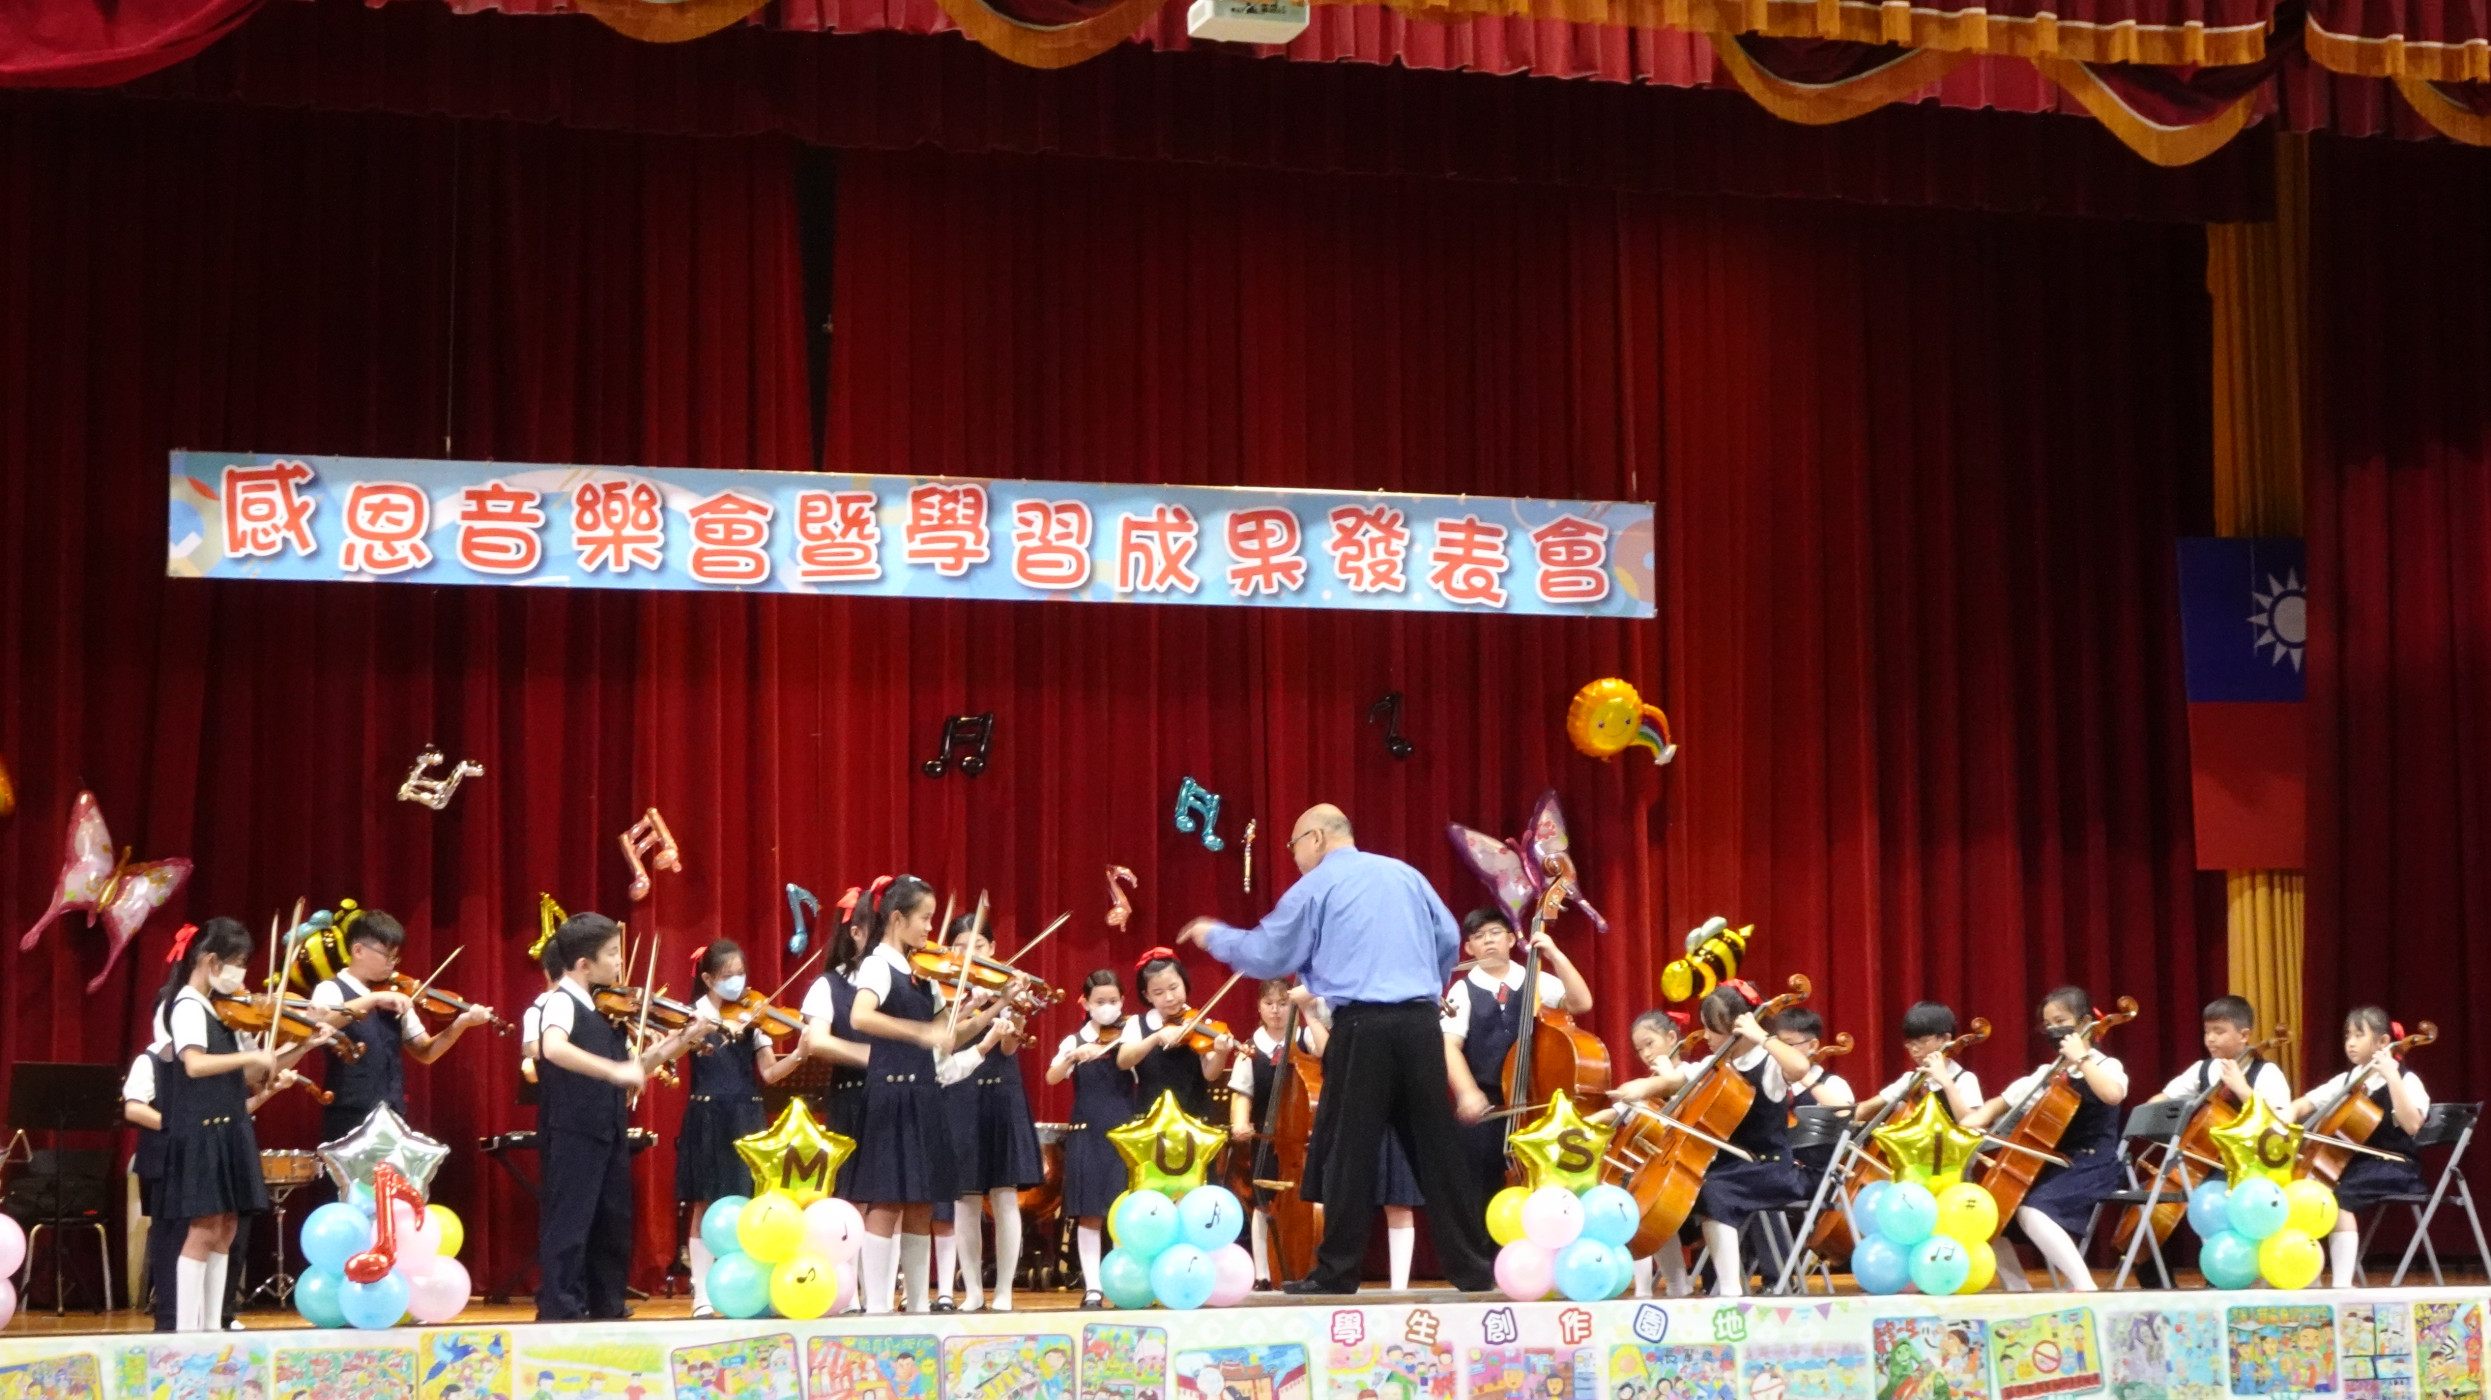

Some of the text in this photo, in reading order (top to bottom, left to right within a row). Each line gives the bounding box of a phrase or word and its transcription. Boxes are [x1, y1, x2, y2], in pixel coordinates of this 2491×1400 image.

[221, 459, 1610, 608] 感恩音樂會暨學習成果發表會
[780, 1142, 828, 1191] M
[1155, 1130, 1195, 1176] U
[1556, 1128, 1594, 1173] S
[2256, 1126, 2293, 1169] C
[1331, 1303, 1747, 1347] 學生創作園地
